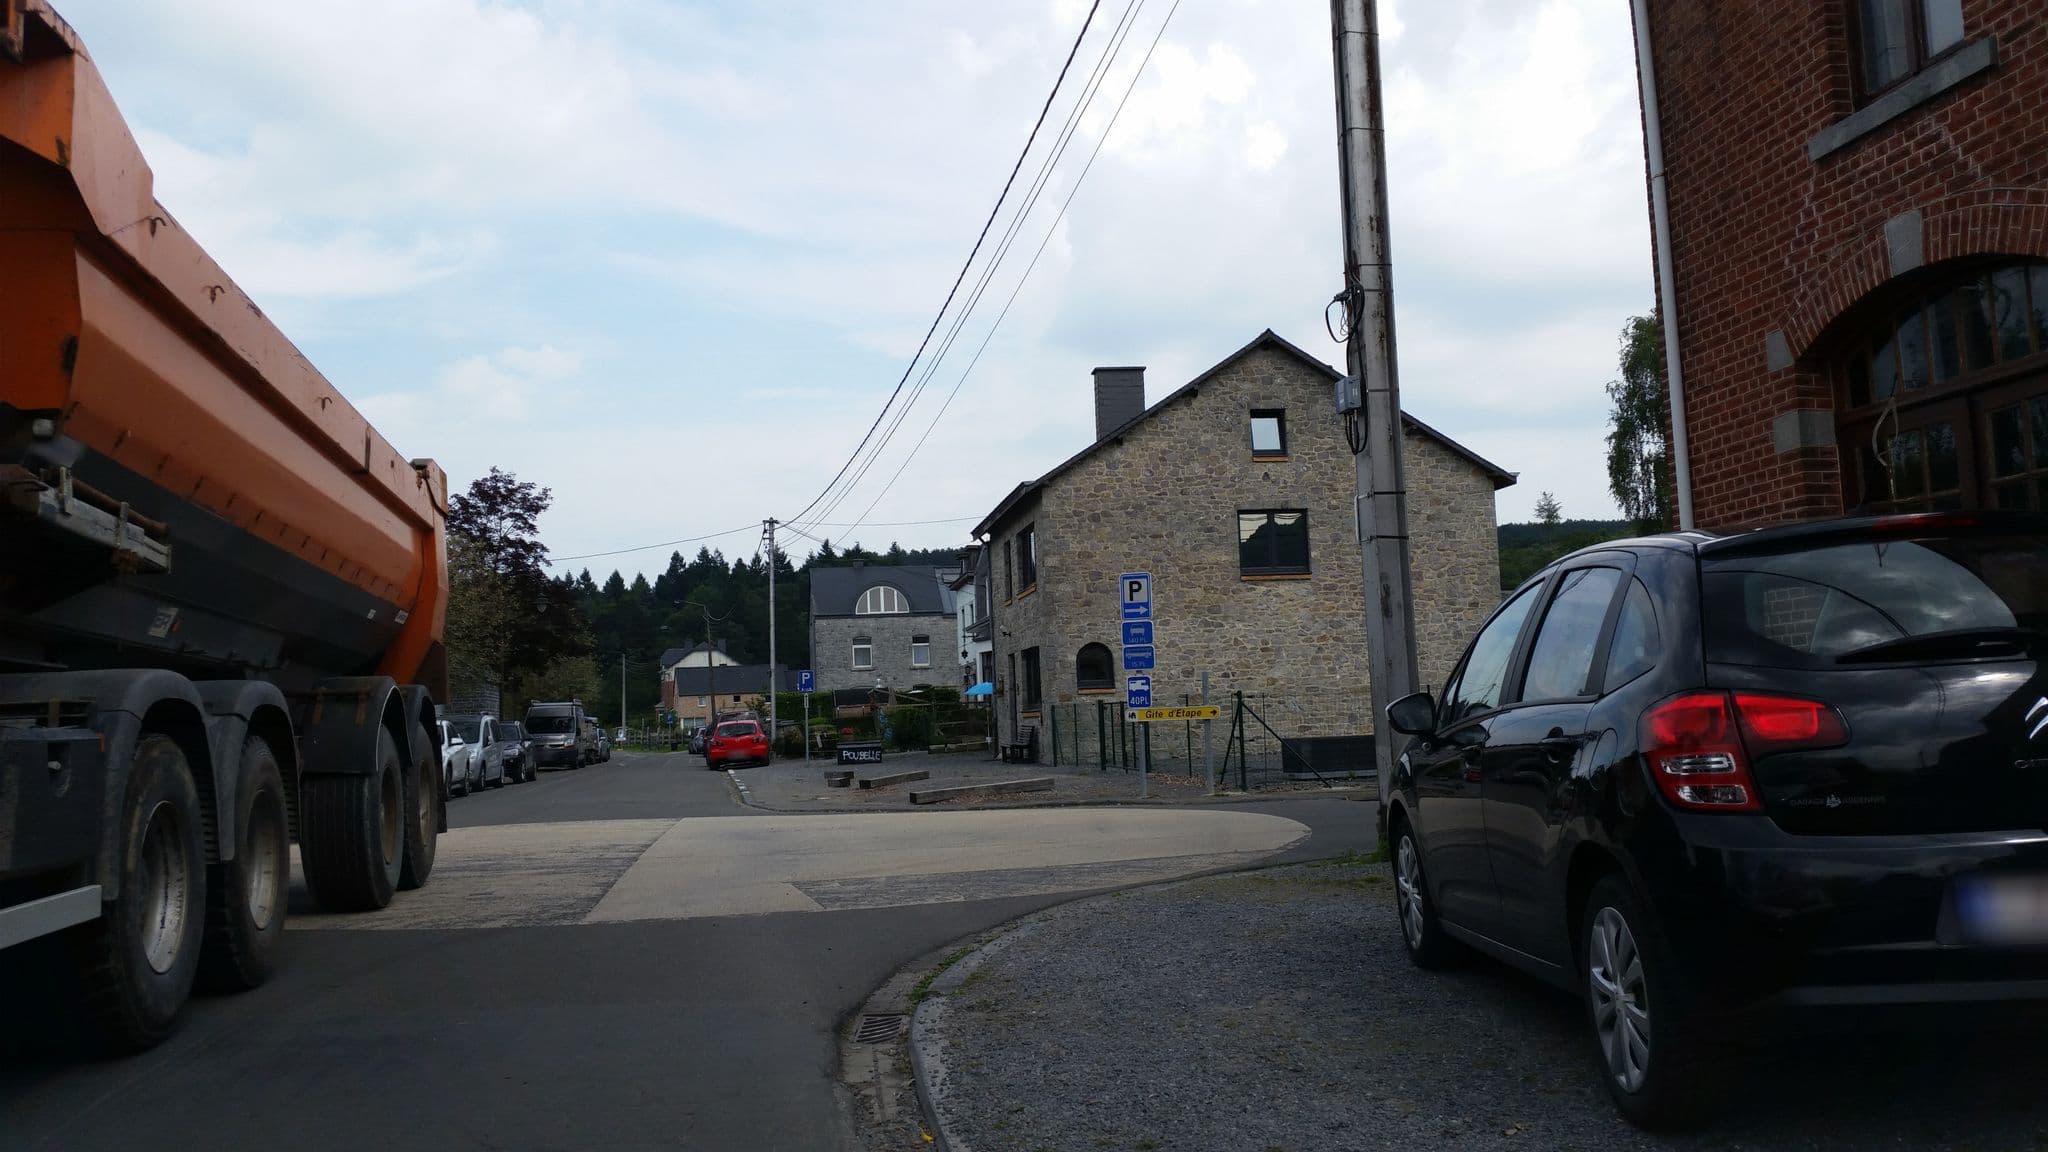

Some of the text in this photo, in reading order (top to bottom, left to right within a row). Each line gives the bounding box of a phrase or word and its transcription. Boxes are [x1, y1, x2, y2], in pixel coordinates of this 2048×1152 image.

[1129, 580, 1142, 602] P
[802, 672, 810, 685] P
[842, 750, 881, 761] POUBELLE
